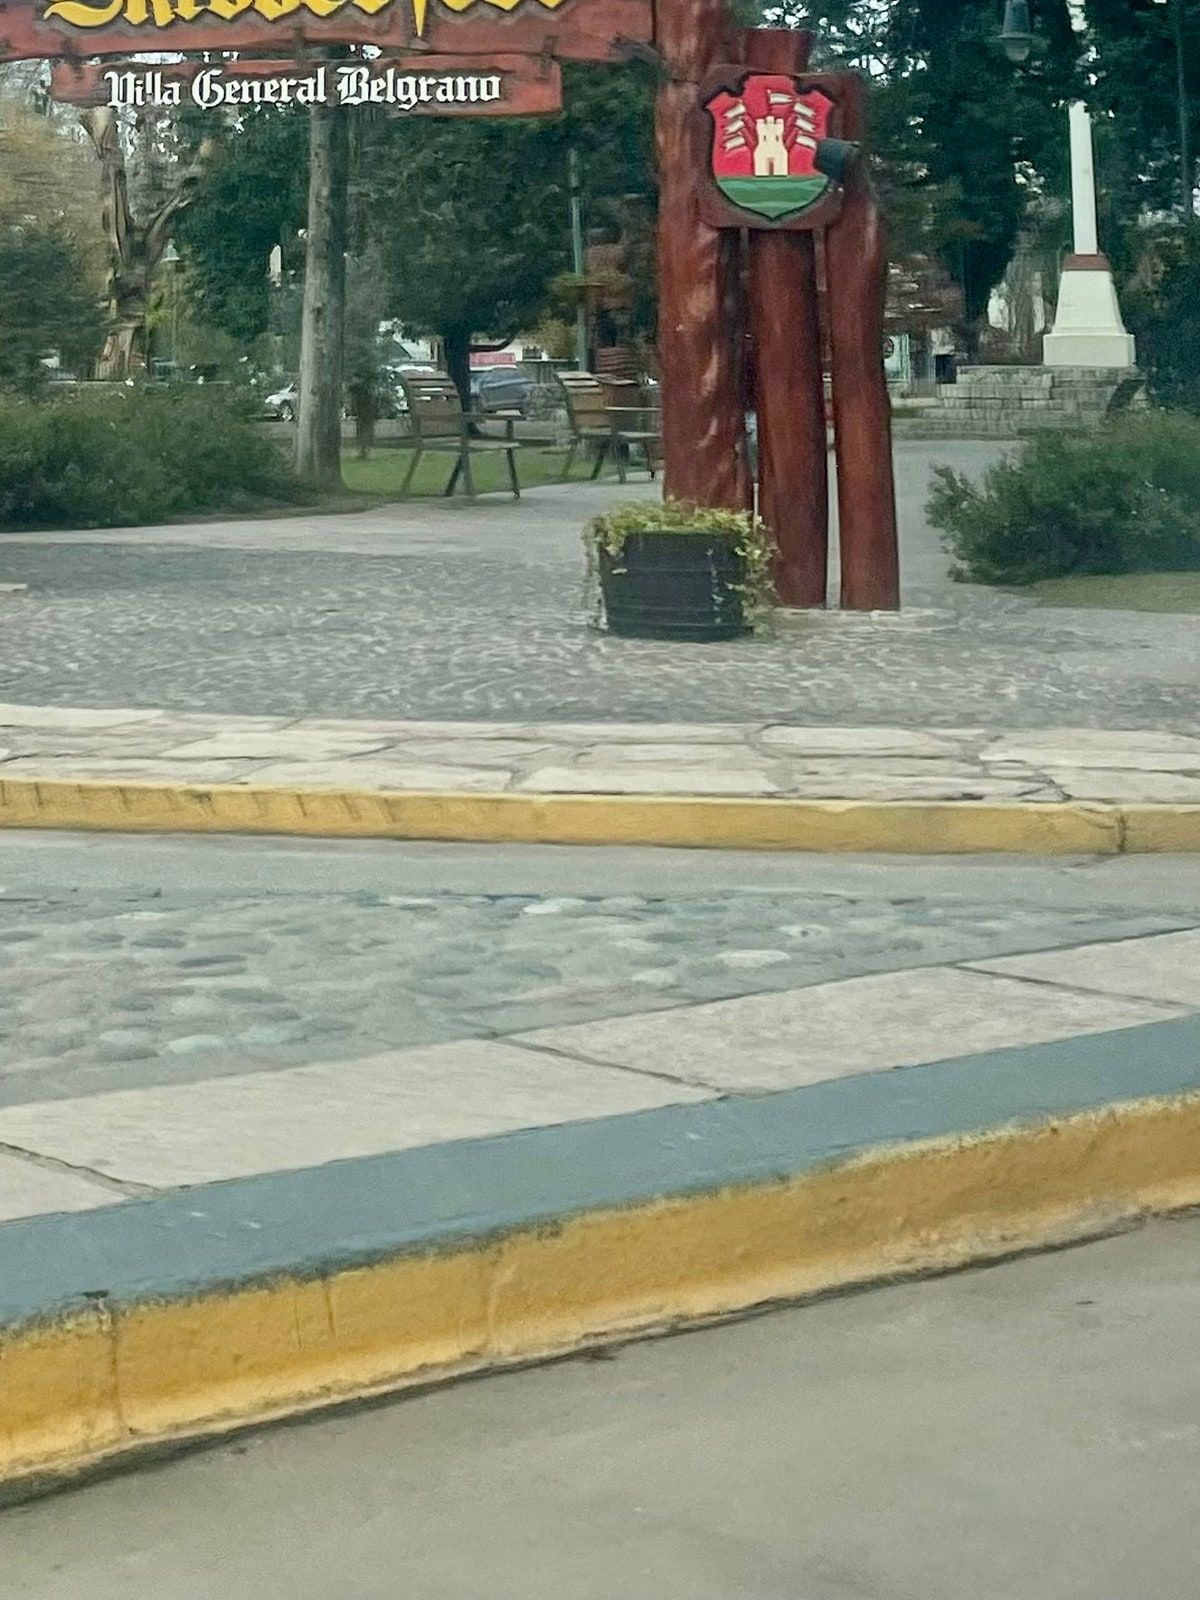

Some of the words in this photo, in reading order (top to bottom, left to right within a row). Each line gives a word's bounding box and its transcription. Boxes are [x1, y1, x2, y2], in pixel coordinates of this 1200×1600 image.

[103, 70, 182, 107] Villa
[191, 66, 327, 109] General
[336, 65, 501, 110] Belgrano
